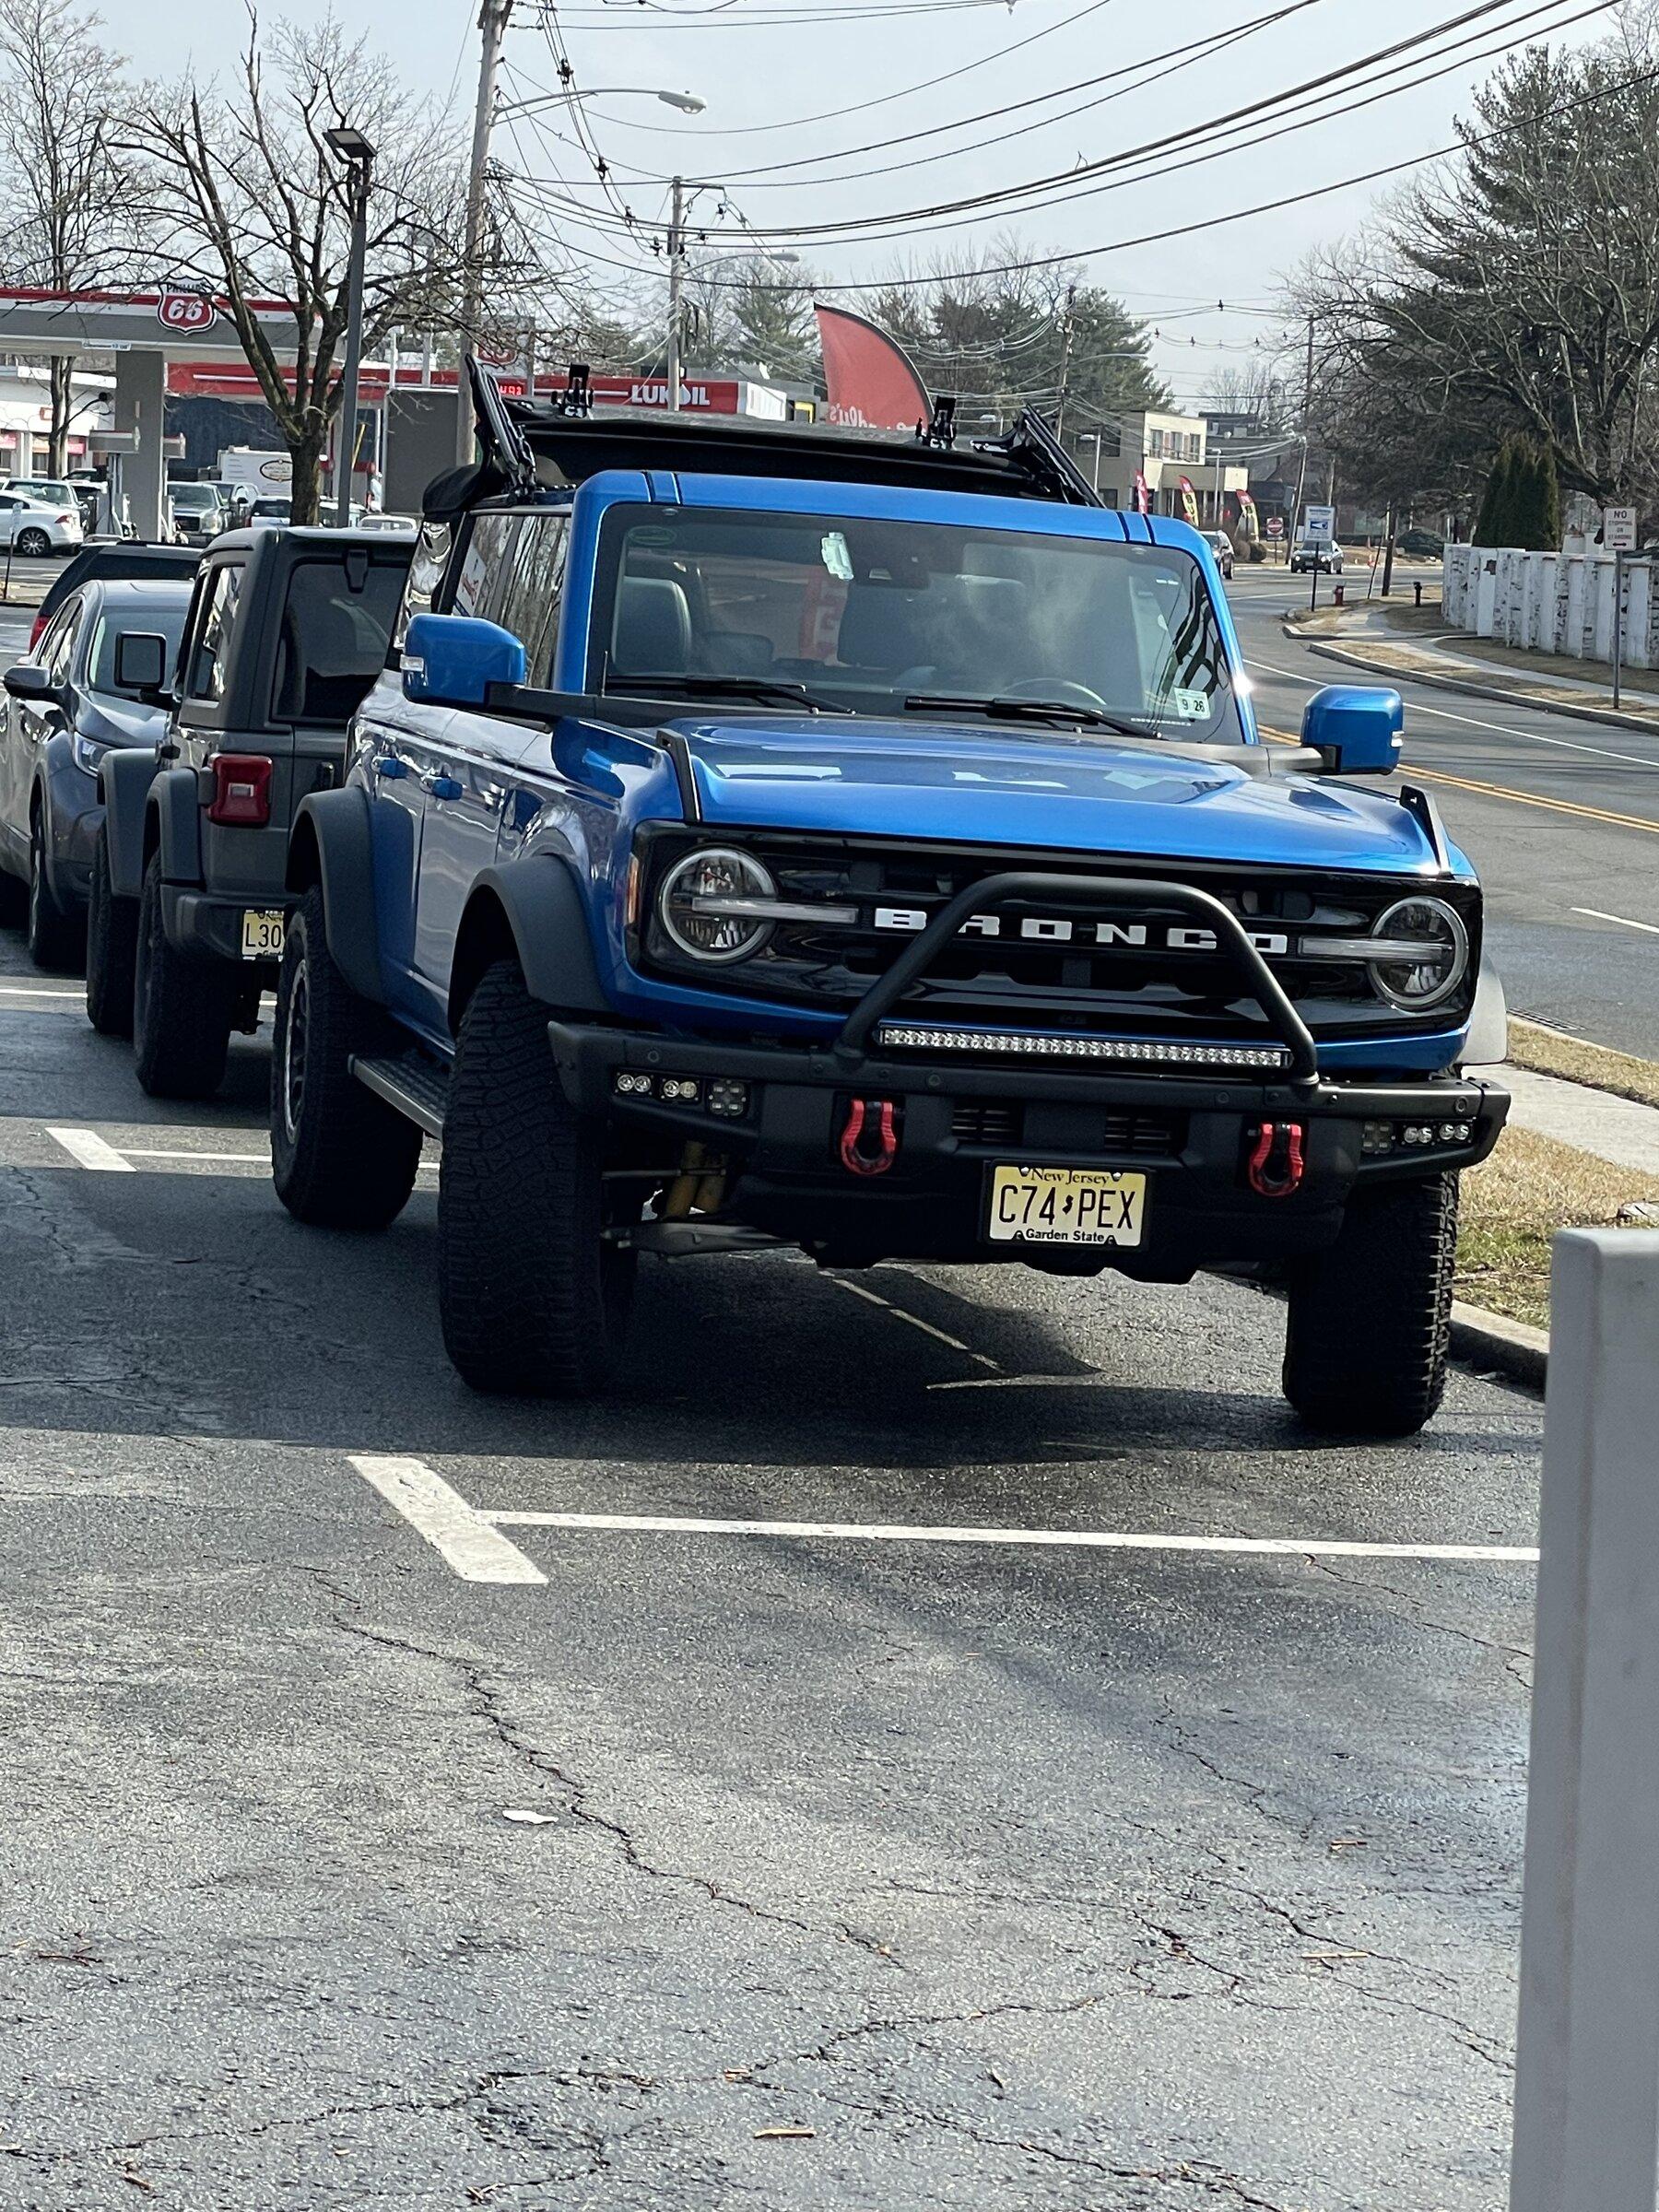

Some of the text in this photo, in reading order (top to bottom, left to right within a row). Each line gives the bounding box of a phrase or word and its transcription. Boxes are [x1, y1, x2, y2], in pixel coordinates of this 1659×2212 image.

[168, 299, 205, 321] 66
[631, 383, 712, 406] LUKOIL
[1614, 510, 1628, 519] NO
[1182, 698, 1206, 712] 9 26
[874, 907, 1288, 954] BRONCO
[1031, 1168, 1110, 1186] New Jersey
[998, 1184, 1135, 1230] C74 PEX
[1026, 1228, 1105, 1243] Garden State
